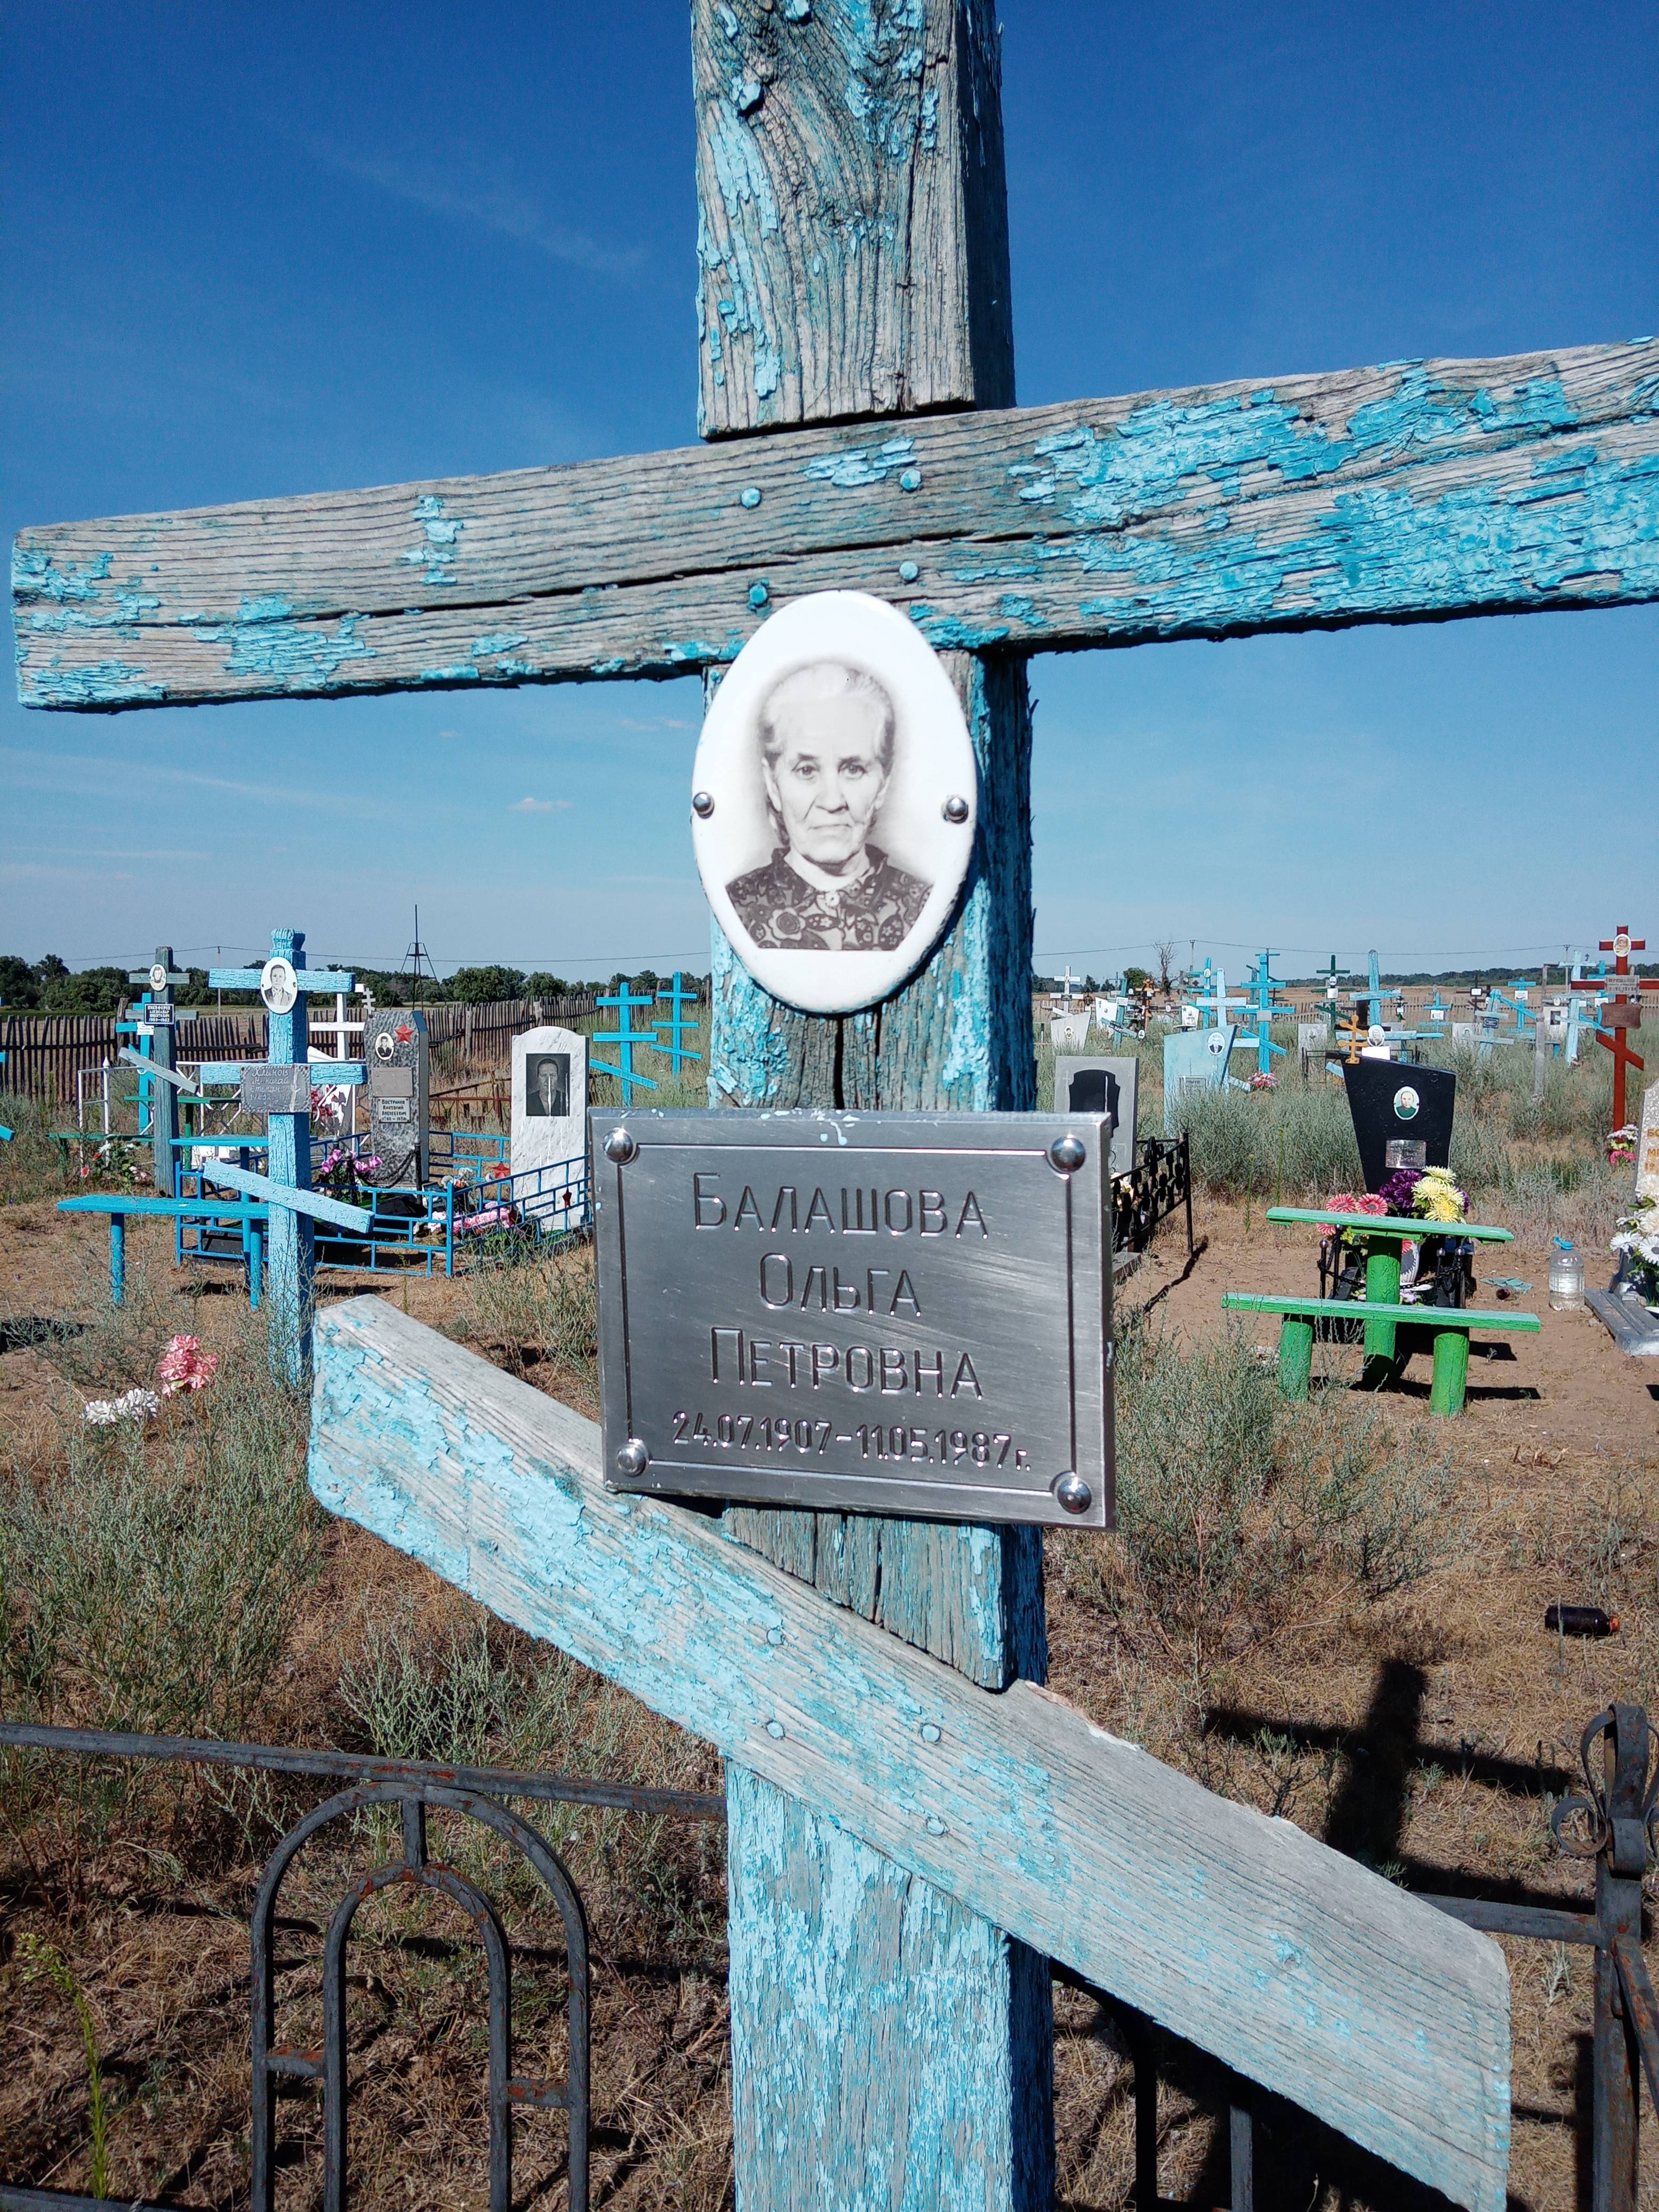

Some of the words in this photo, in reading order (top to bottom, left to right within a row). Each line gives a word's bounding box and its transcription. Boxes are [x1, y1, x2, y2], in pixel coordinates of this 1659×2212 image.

[693, 1171, 988, 1239] БАЛАШОВА
[759, 1252, 922, 1317] ОЛЬГА
[710, 1327, 983, 1401] ПЕТРОВНА
